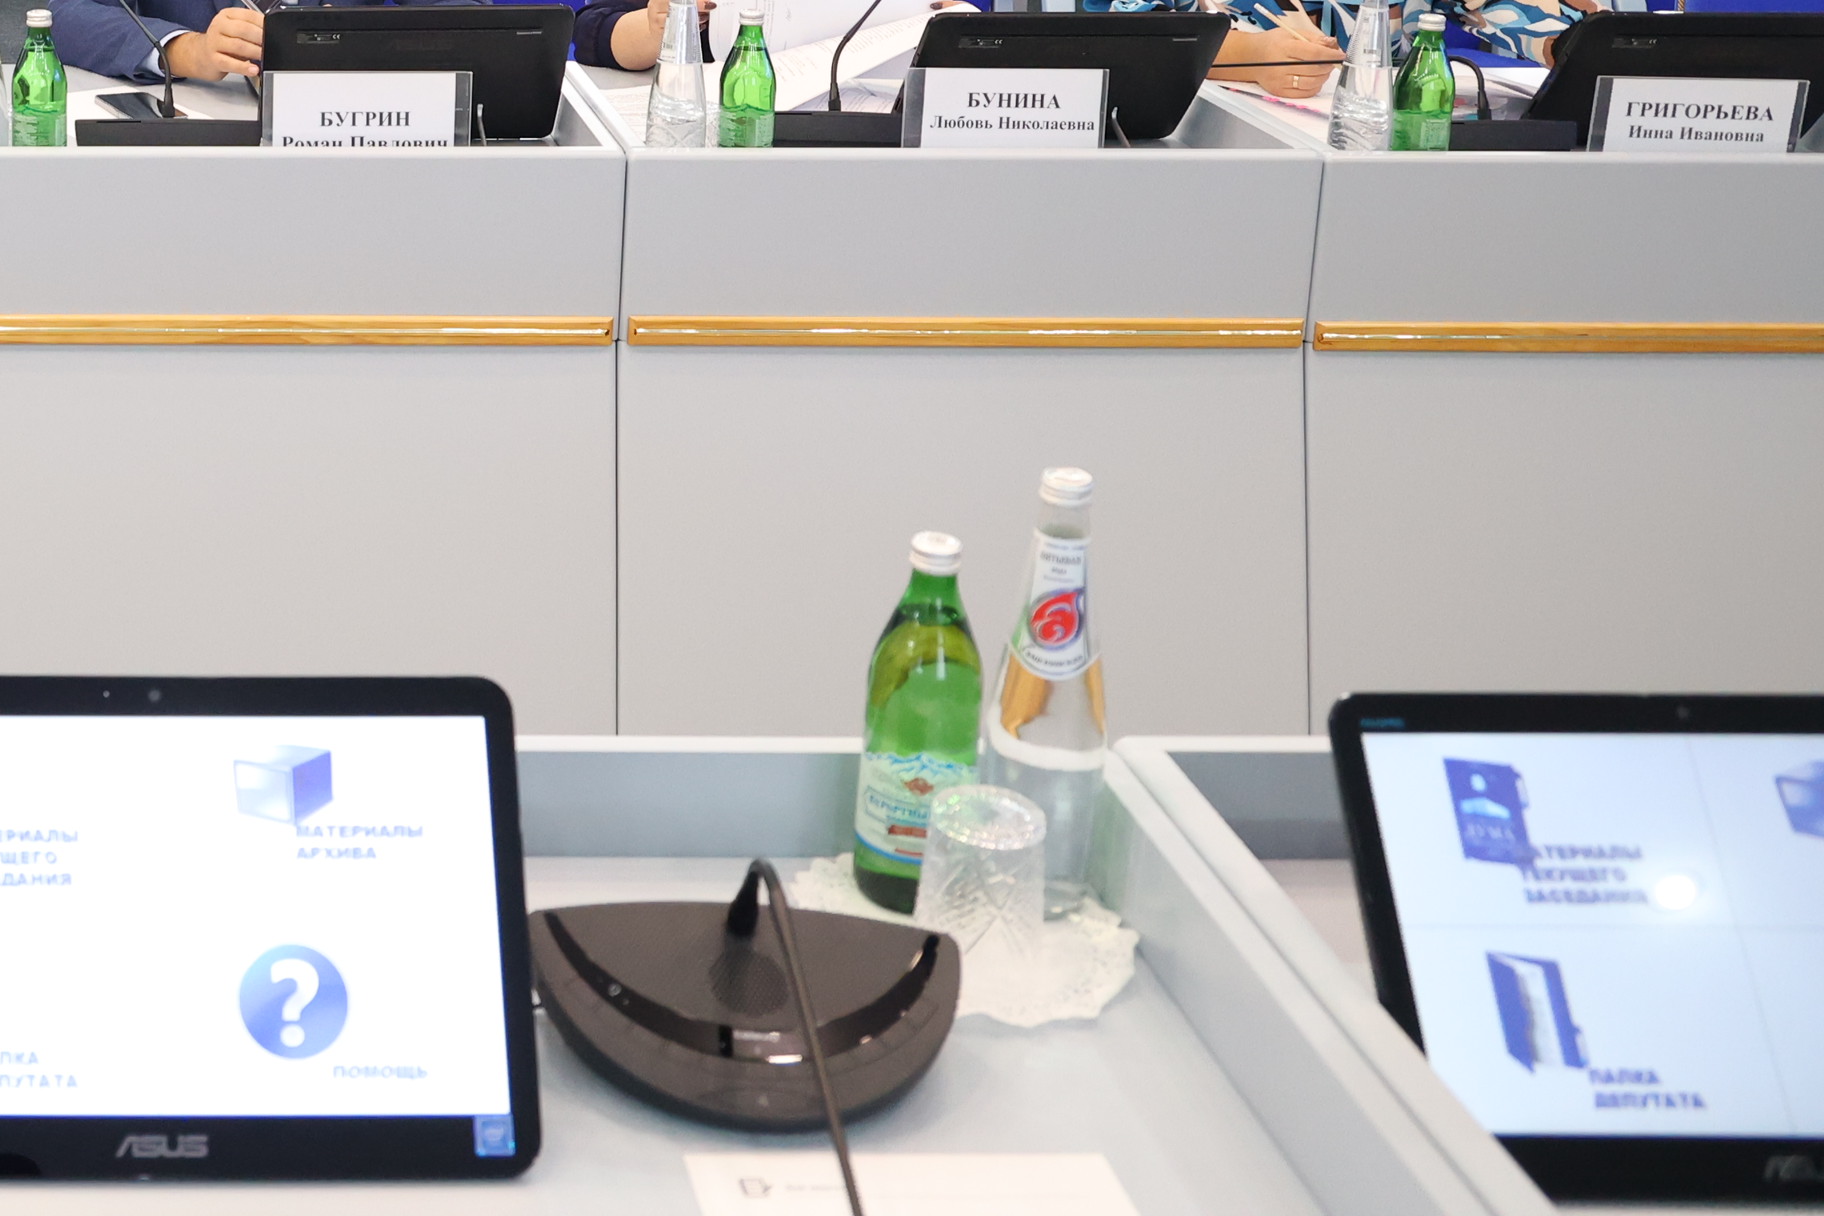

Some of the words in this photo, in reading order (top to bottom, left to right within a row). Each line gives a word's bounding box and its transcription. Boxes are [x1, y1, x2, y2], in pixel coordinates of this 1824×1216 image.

[967, 92, 1061, 109] БУНИНА
[320, 111, 410, 127] БУГРИН
[1625, 101, 1774, 122] ГРИГОРЬЕВА
[930, 115, 993, 129] Любовь
[998, 116, 1095, 131] Николаевна
[1628, 124, 1674, 139] Инна
[1679, 126, 1765, 142] Ивановна
[115, 1134, 210, 1159] ASUS
